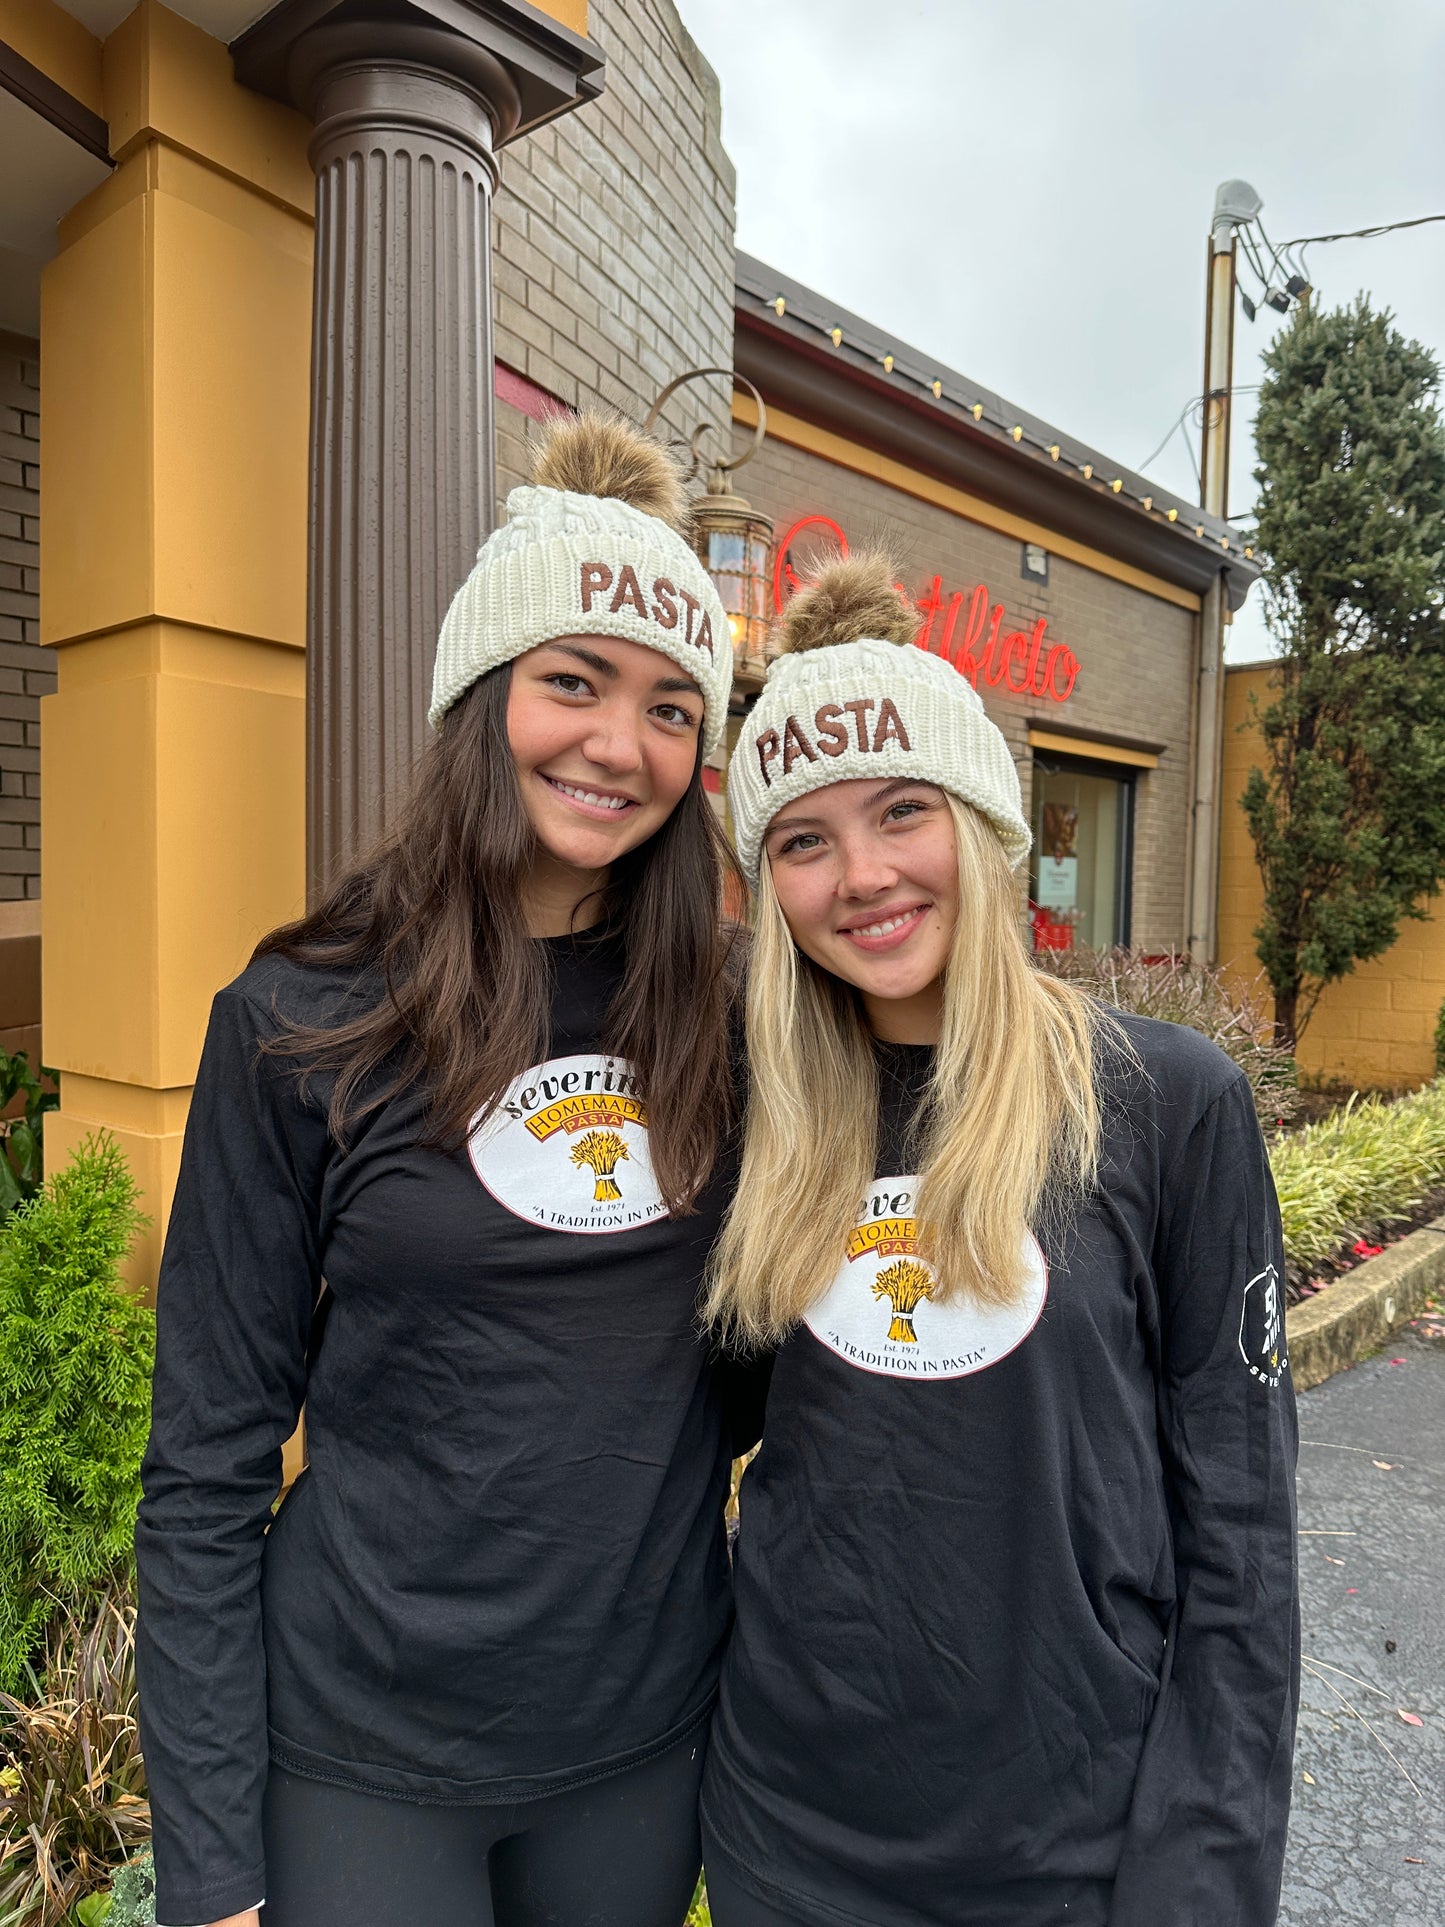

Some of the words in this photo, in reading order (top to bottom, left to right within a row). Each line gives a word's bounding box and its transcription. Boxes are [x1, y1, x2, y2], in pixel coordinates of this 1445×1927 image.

[580, 562, 714, 667] PASTA
[756, 697, 911, 788] PASTA
[504, 1060, 641, 1120] severin
[566, 1113, 621, 1131] PASTA
[550, 1211, 623, 1228] TRADITION
[628, 1209, 642, 1222] IN
[845, 1221, 918, 1253] HOME
[844, 1340, 918, 1372] TRADITION
[923, 1360, 938, 1373] IN
